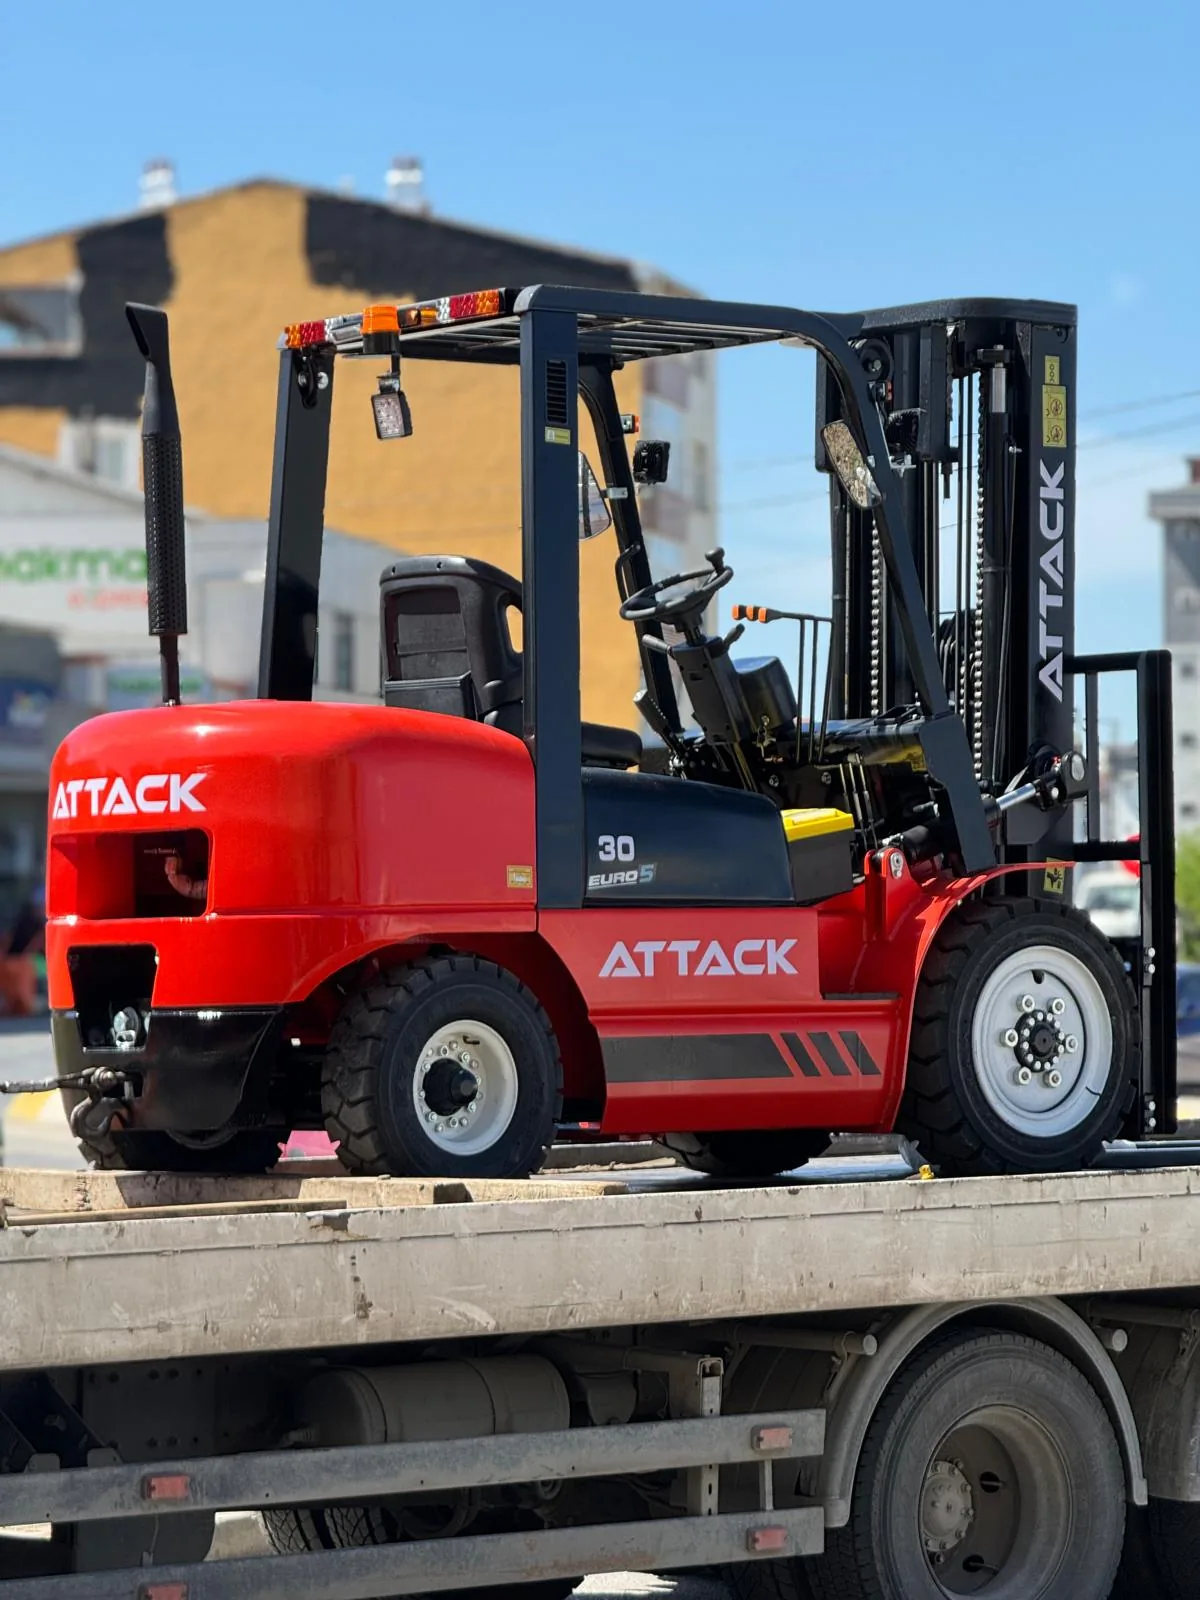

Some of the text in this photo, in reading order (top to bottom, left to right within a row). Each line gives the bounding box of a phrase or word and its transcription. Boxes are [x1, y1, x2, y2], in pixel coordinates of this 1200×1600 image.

[1039, 459, 1065, 702] ATTACK
[52, 773, 207, 819] ATTACK
[598, 834, 635, 861] 30
[598, 938, 799, 977] ATTACK
